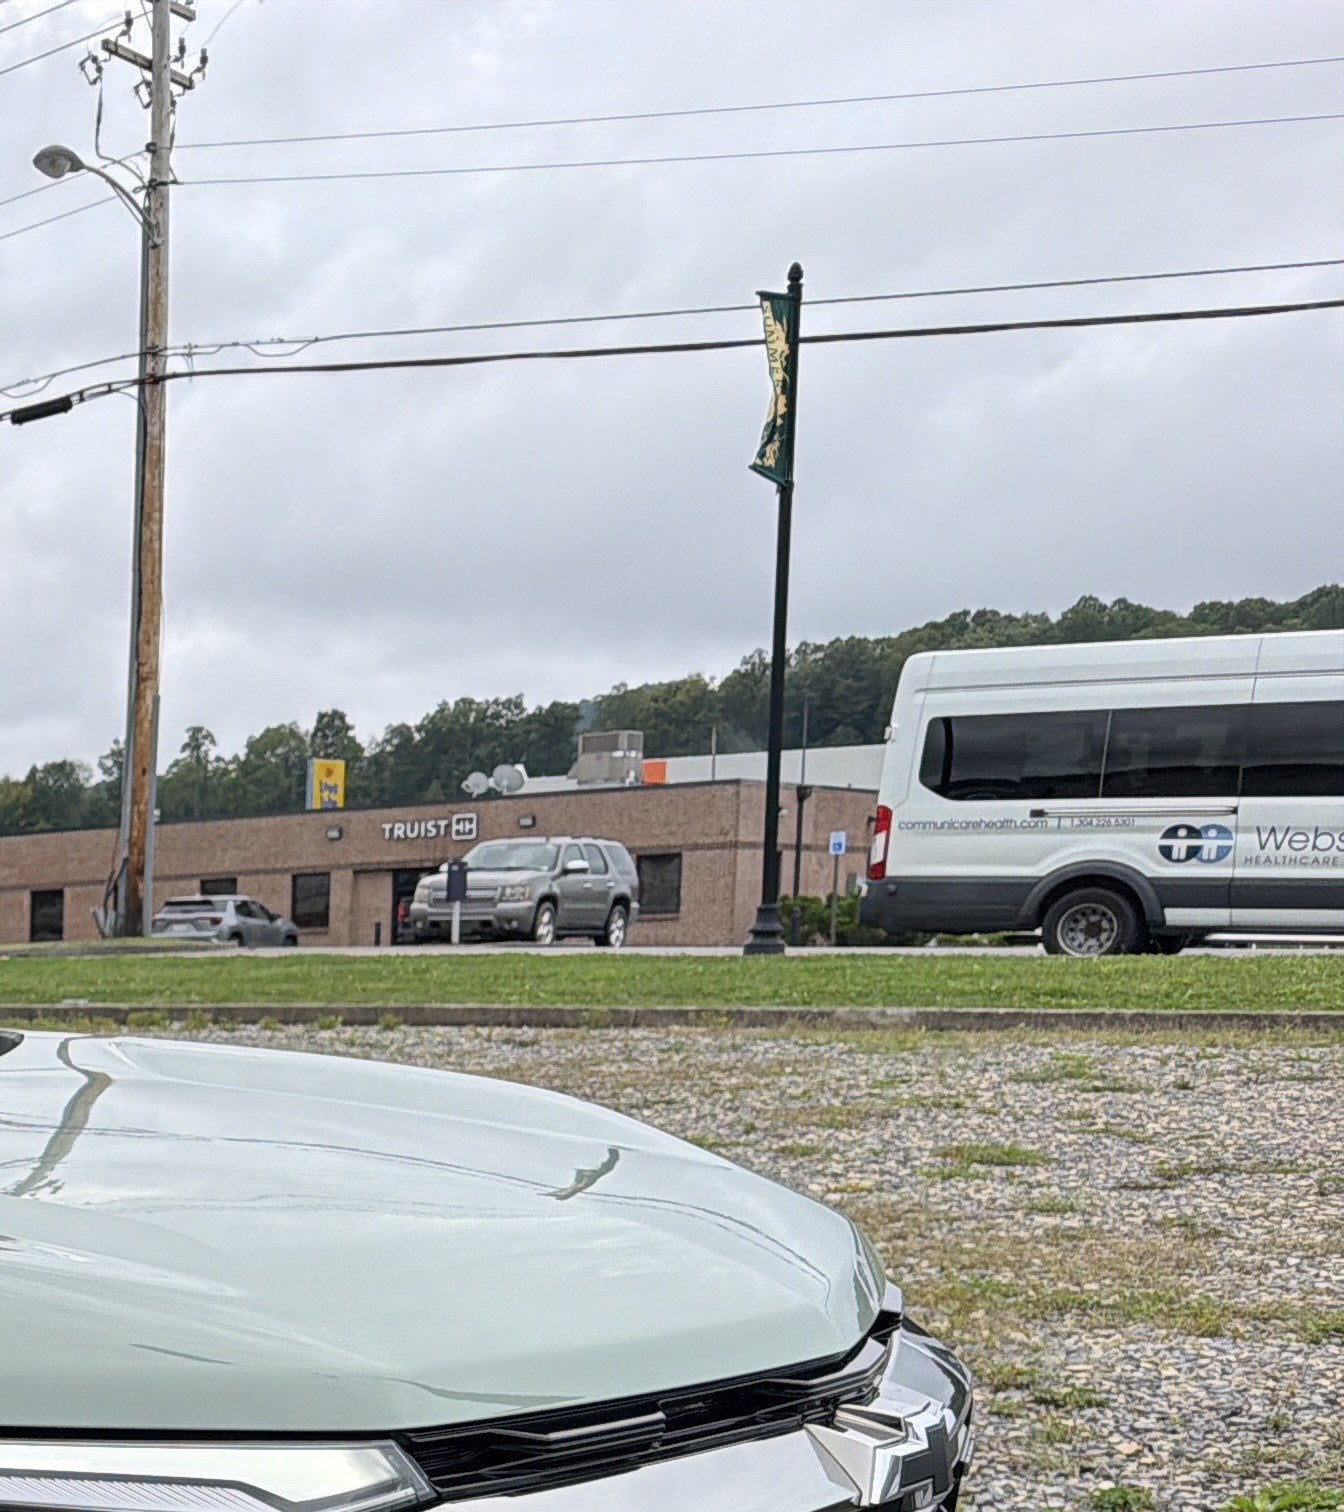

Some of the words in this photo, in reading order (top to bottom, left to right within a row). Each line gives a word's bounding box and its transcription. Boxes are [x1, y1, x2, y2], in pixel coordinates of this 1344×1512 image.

[381, 818, 449, 840] TRUIST
[898, 817, 1049, 832] communicarehealth.com
[1243, 855, 1339, 867] HEALTHCARE
